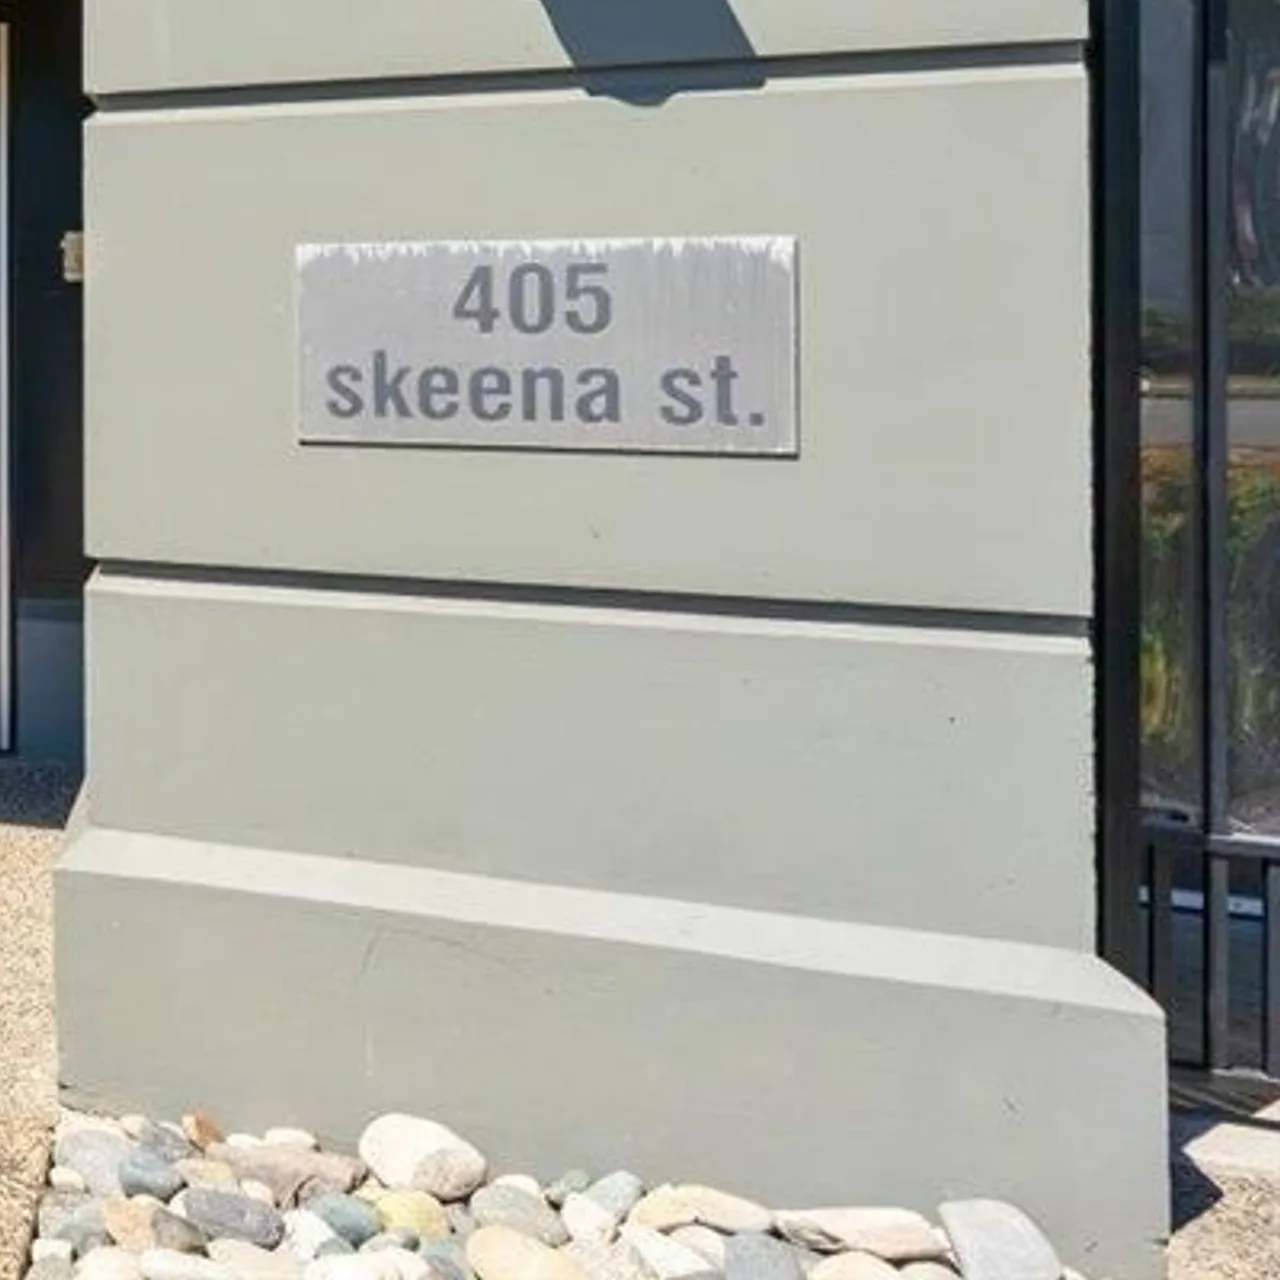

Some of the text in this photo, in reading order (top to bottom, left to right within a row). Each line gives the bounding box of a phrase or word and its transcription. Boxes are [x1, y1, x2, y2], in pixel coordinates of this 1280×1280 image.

[453, 262, 613, 335] 405
[325, 349, 766, 426] skeena st.
